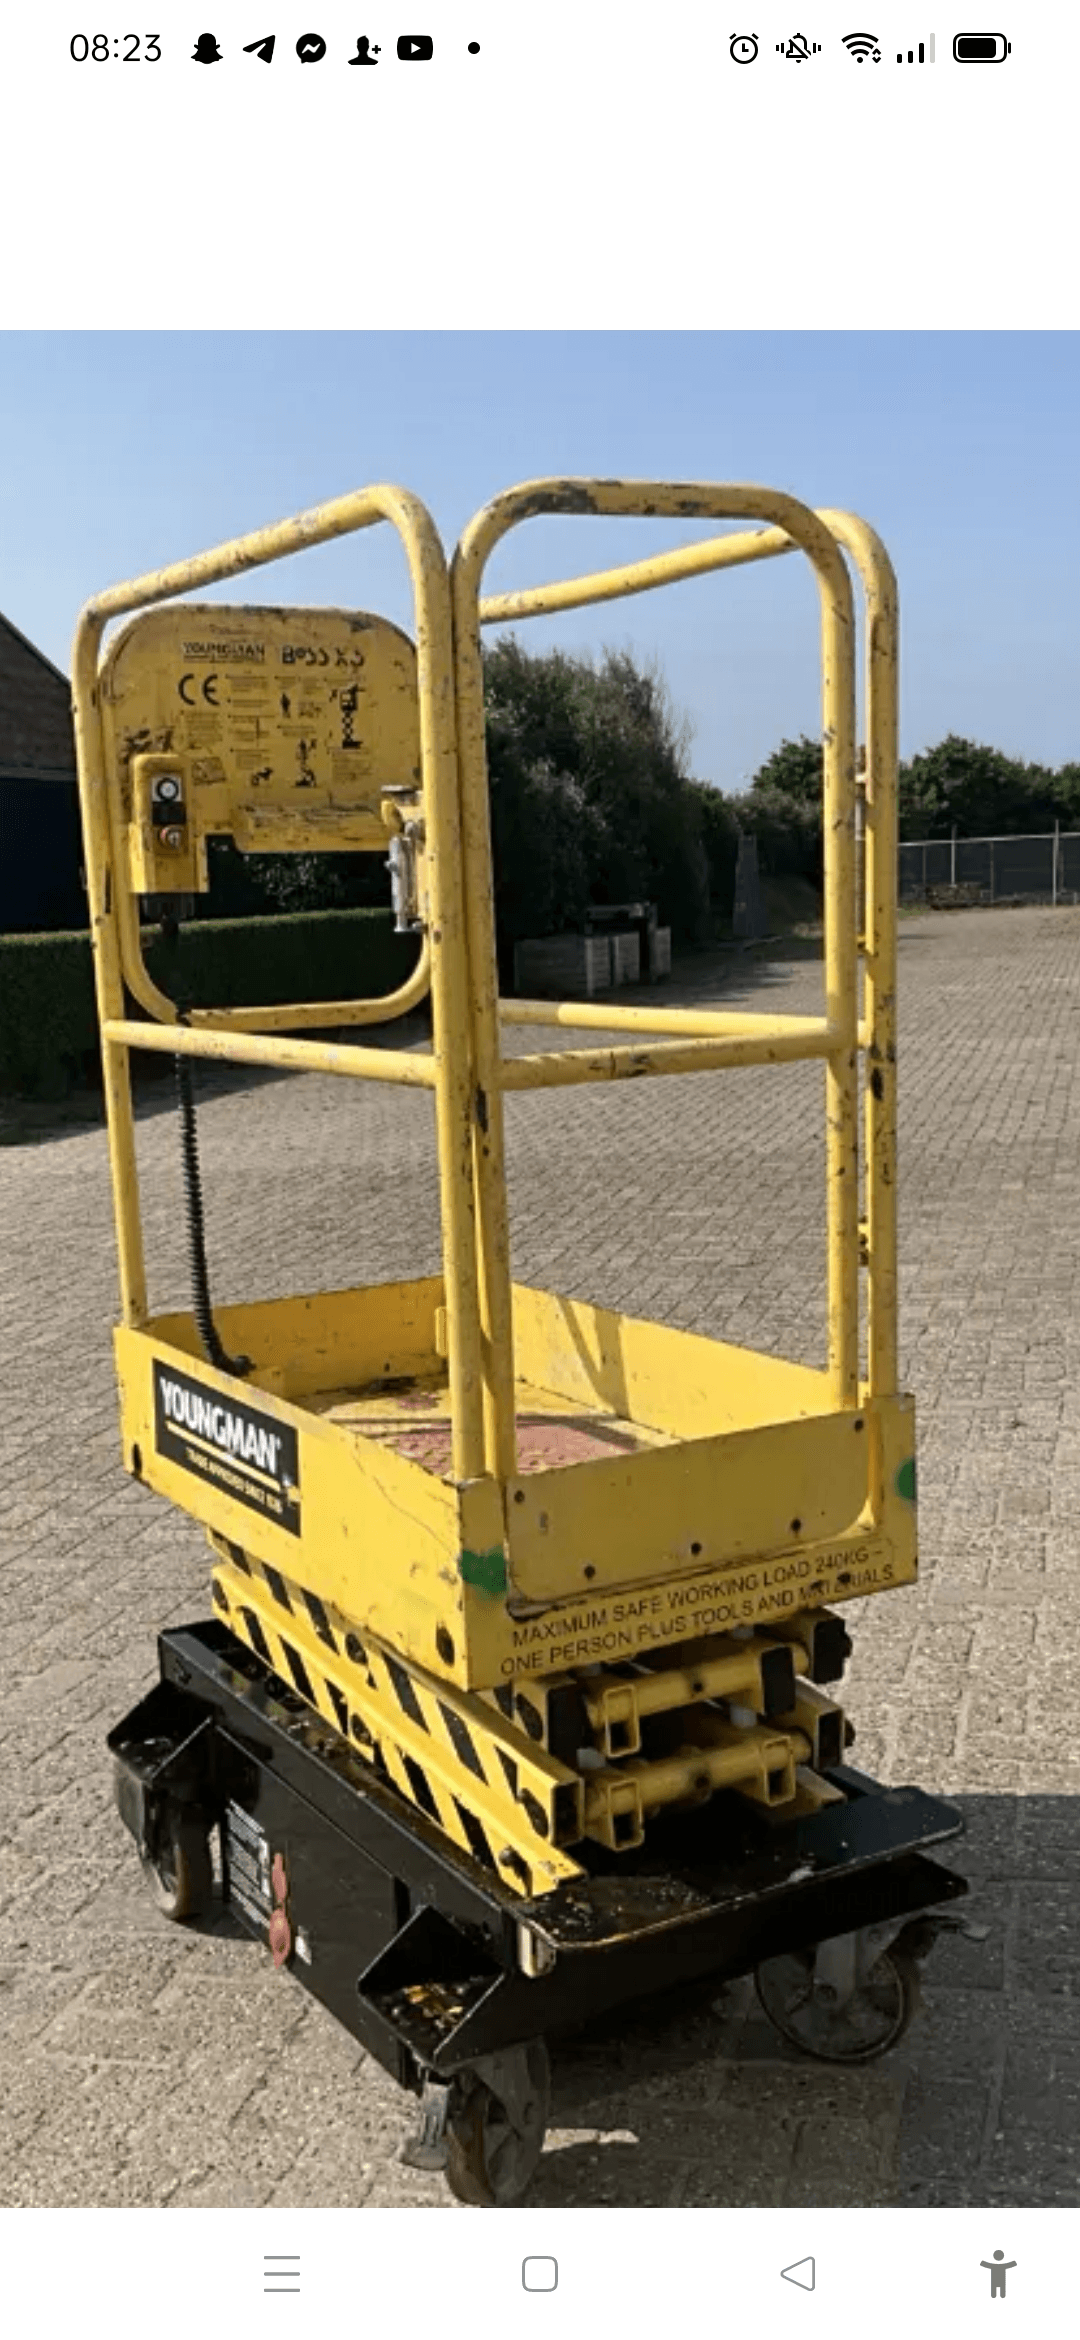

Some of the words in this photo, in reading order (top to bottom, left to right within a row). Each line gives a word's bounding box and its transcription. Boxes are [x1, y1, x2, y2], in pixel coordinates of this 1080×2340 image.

[178, 672, 221, 706] CE
[501, 1650, 544, 1675] ONE
[550, 1630, 631, 1663] PERSON
[638, 1616, 687, 1642] PLUS
[691, 1600, 754, 1627] TOOLS
[759, 1589, 794, 1612] AND
[513, 1608, 607, 1647] MAXIMUM
[613, 1595, 661, 1622] SAFE
[667, 1573, 758, 1611] WORKING
[763, 1561, 810, 1587] LOAD
[816, 1546, 869, 1573] 240KG
